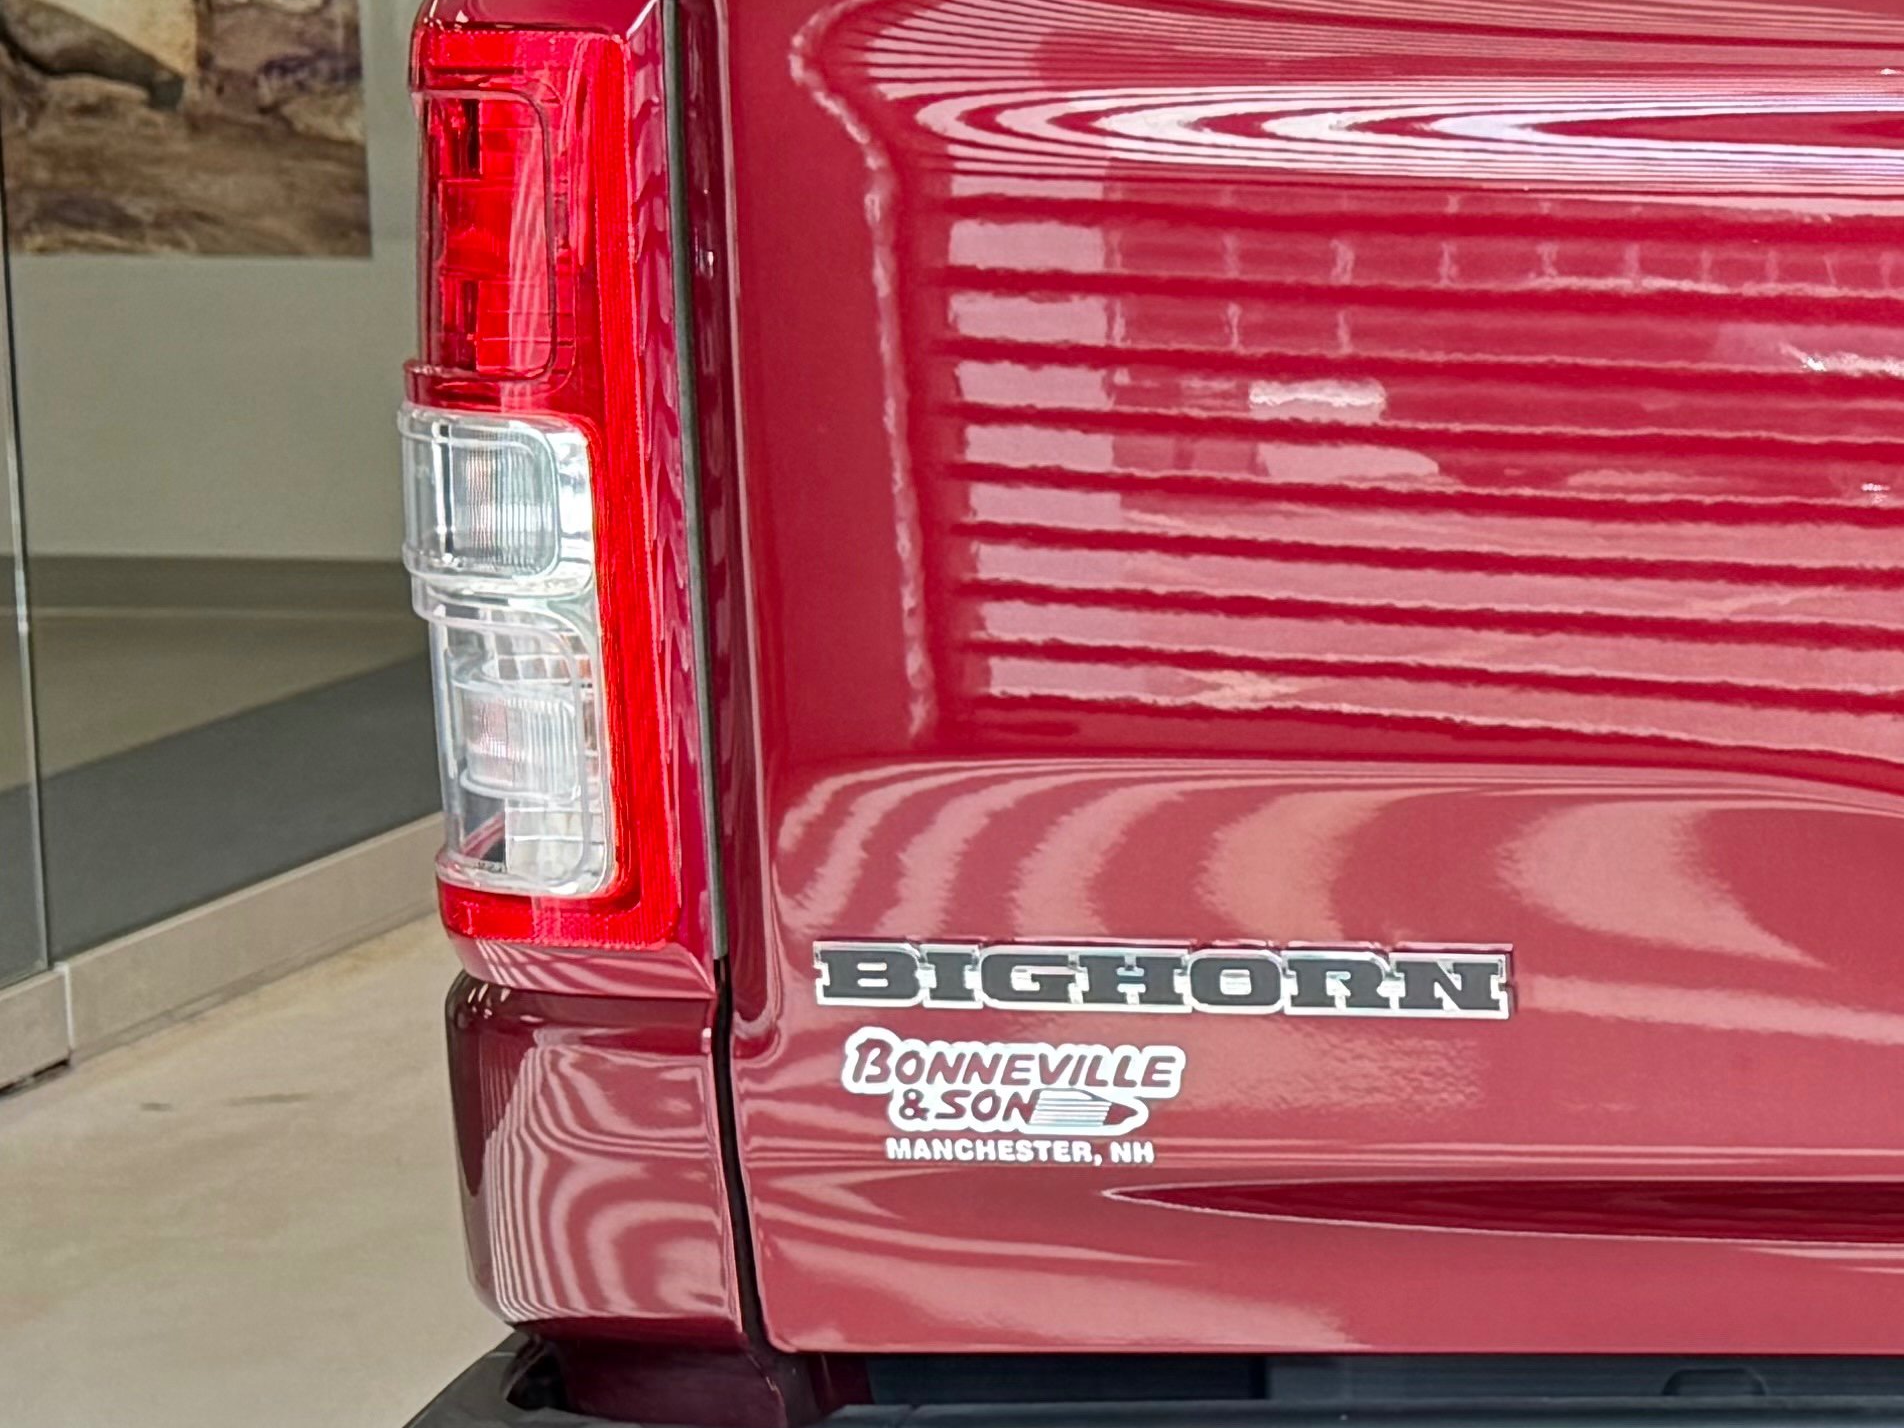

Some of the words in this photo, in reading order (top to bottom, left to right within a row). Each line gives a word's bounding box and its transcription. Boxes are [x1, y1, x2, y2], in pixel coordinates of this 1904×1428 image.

[813, 940, 1513, 1019] BIGHORN
[850, 1037, 1178, 1089] BONNEVILLE
[899, 1088, 931, 1122] &
[934, 1088, 1041, 1125] SON
[885, 1136, 1103, 1166] MANCHESTER,
[1108, 1140, 1155, 1164] NH
